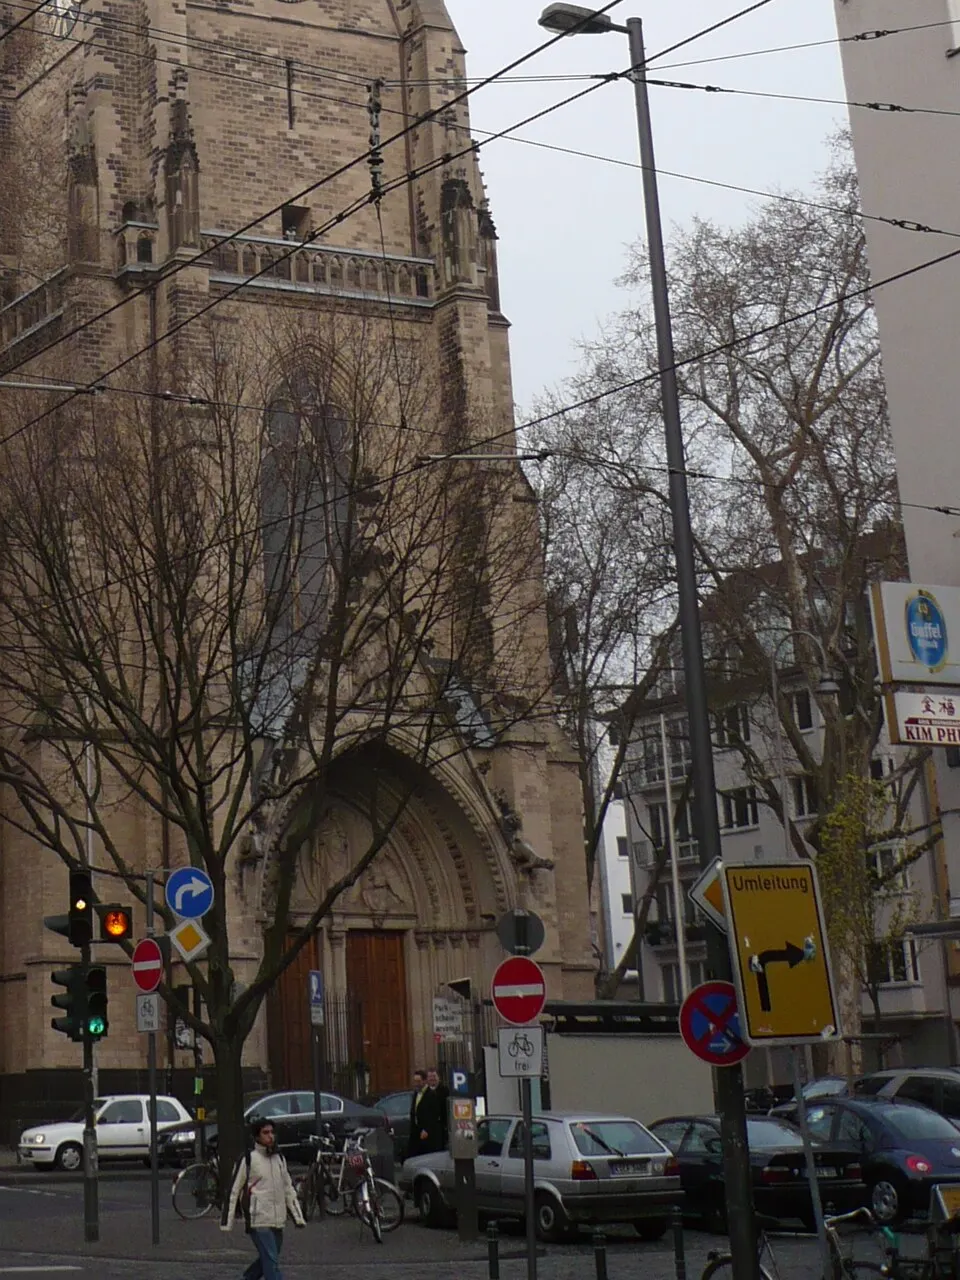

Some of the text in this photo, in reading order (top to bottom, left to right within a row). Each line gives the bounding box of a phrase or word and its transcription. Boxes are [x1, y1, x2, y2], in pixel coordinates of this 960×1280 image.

[910, 623, 941, 638] Gaffel
[905, 726, 933, 740] KIM
[733, 874, 808, 893] Umleitung
[453, 1071, 467, 1091] P
